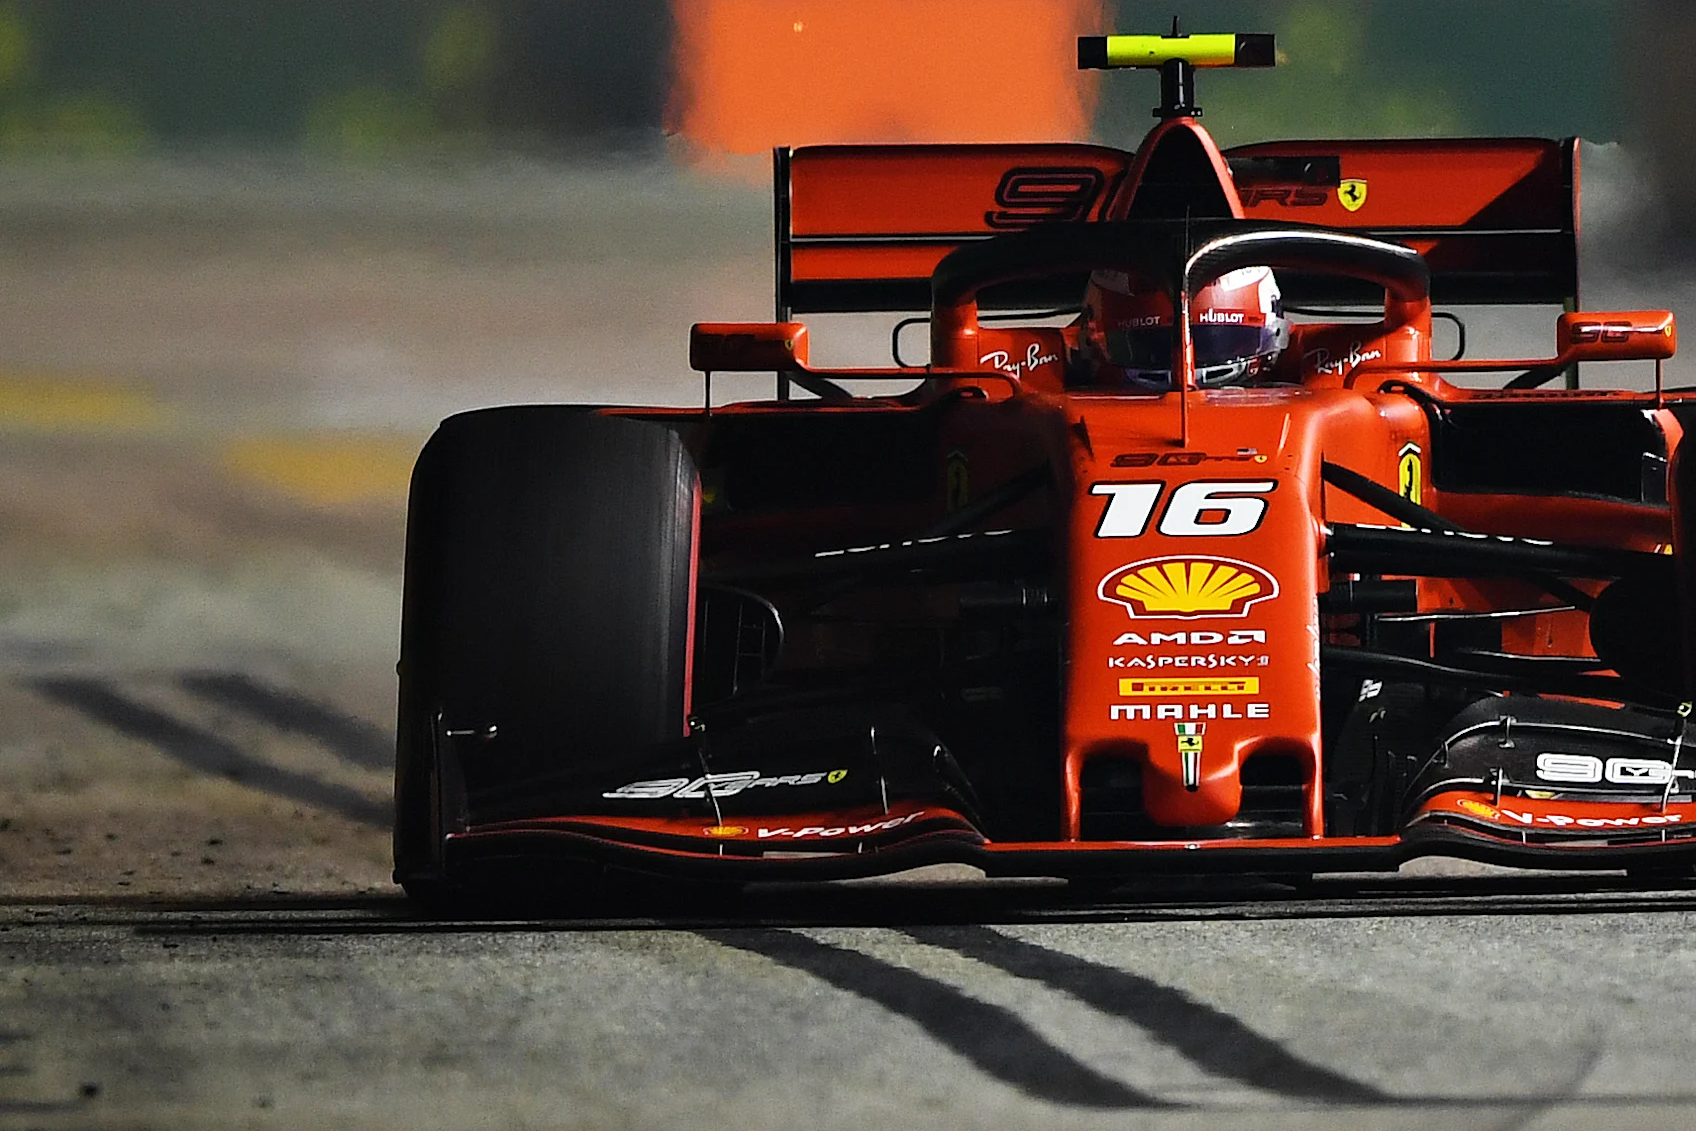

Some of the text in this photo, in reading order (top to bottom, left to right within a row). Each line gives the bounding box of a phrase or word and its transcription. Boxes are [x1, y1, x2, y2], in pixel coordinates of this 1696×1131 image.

[1118, 316, 1161, 327] HUBLOT
[1200, 308, 1244, 323] HUBLOT
[980, 343, 1058, 378] Ray-Ban
[1303, 342, 1381, 375] Ray-Ban
[1091, 480, 1278, 538] 16
[1110, 704, 1269, 720] MAHLE
[757, 811, 925, 839] V-Power
[1501, 809, 1682, 827] V-Power
